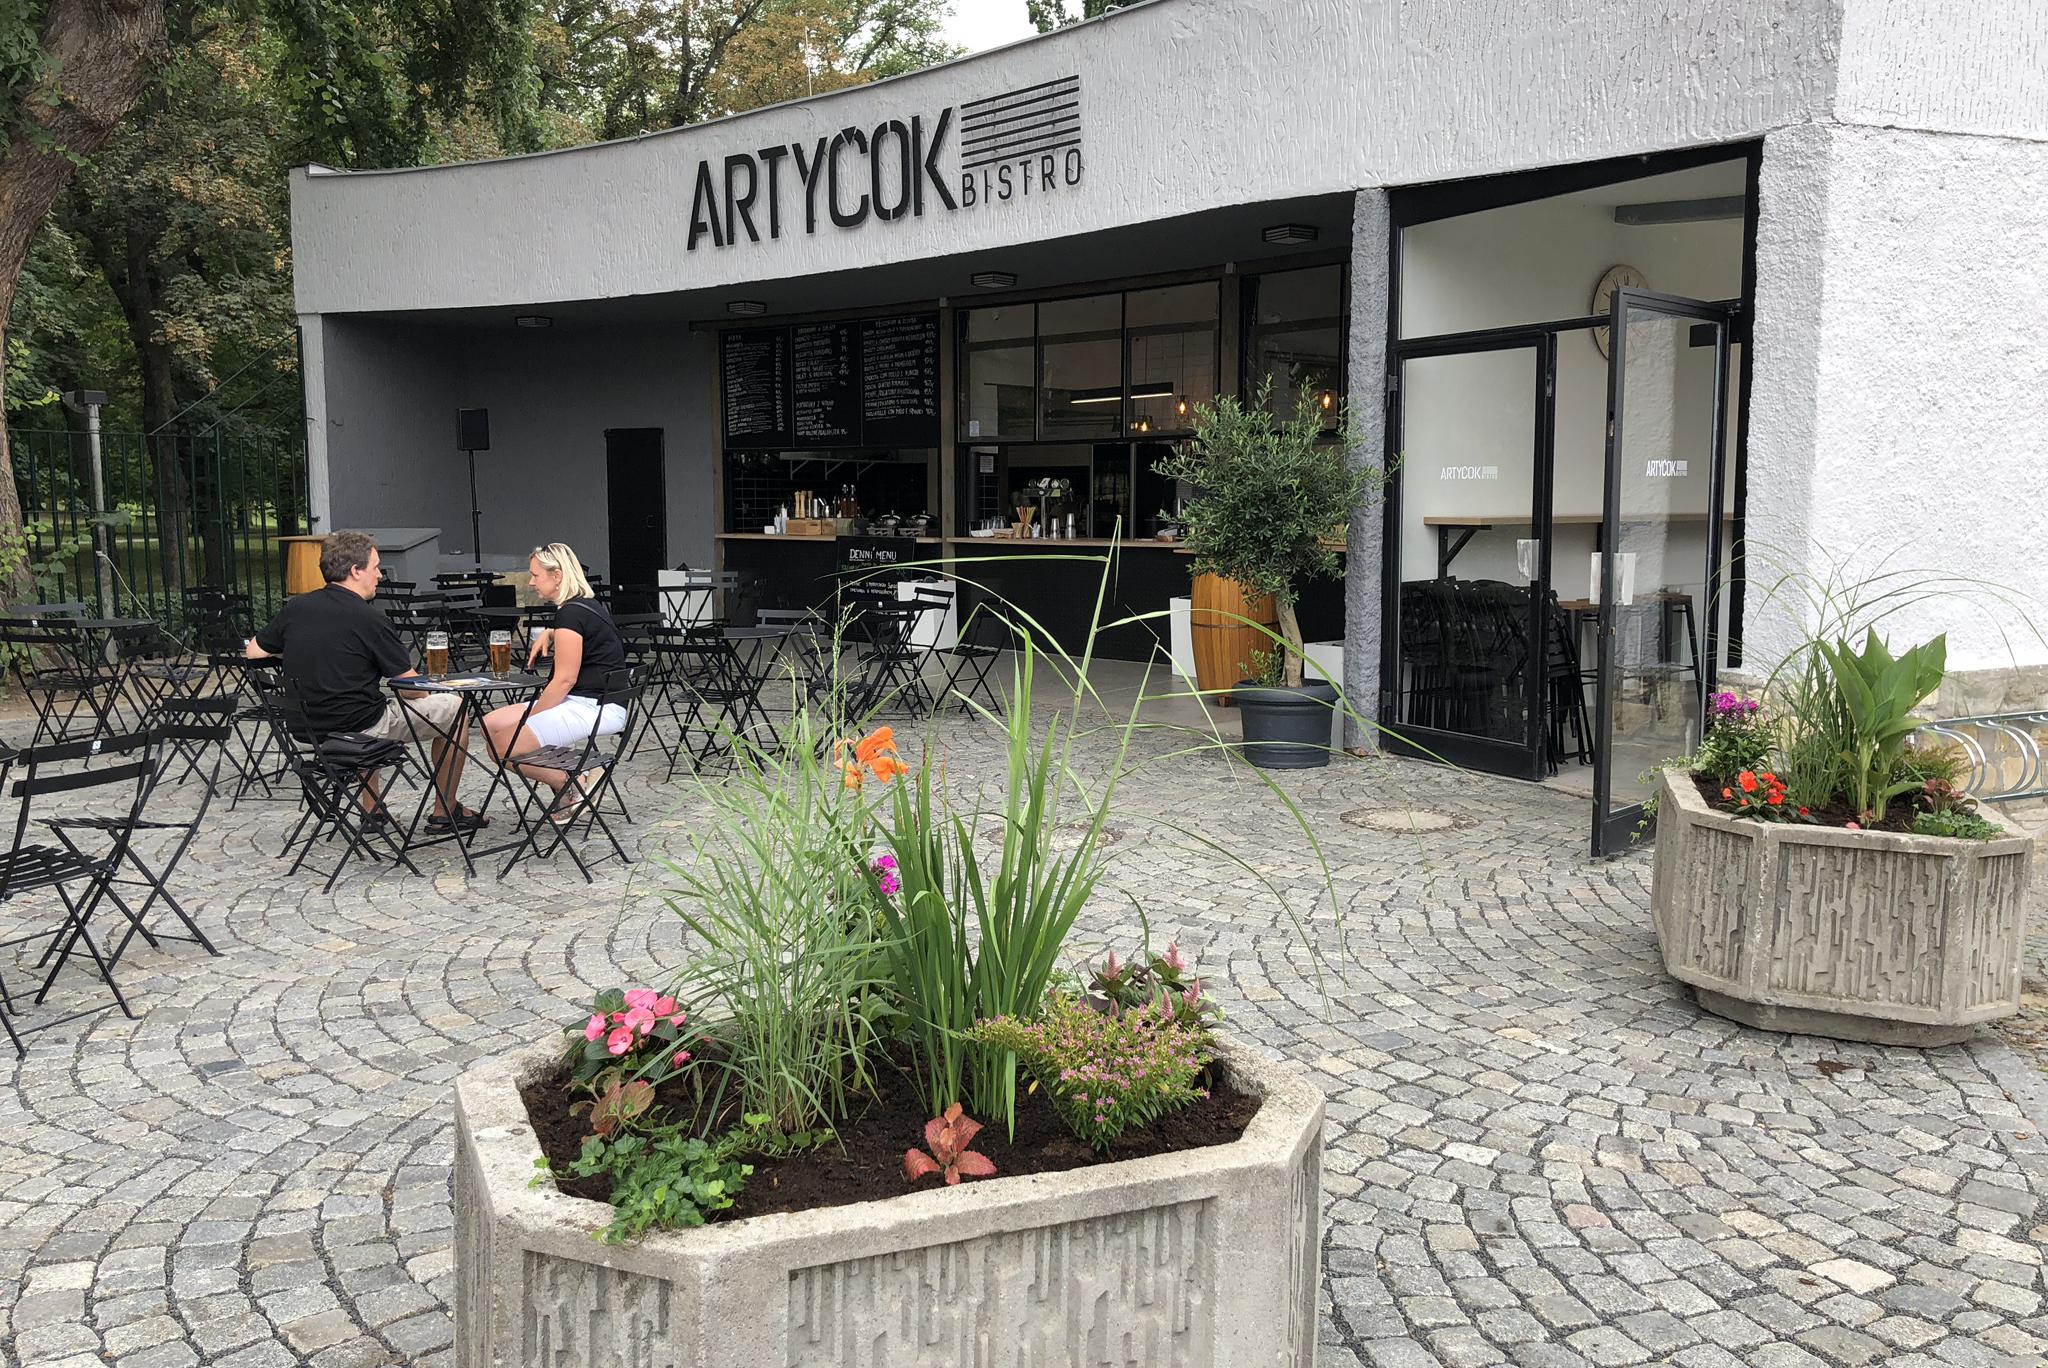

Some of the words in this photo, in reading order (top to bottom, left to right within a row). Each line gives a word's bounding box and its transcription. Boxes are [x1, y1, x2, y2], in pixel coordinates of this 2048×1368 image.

[962, 148, 1082, 208] BISTRO
[1440, 465, 1481, 480] ARTYCOK
[875, 550, 897, 560] MENU
